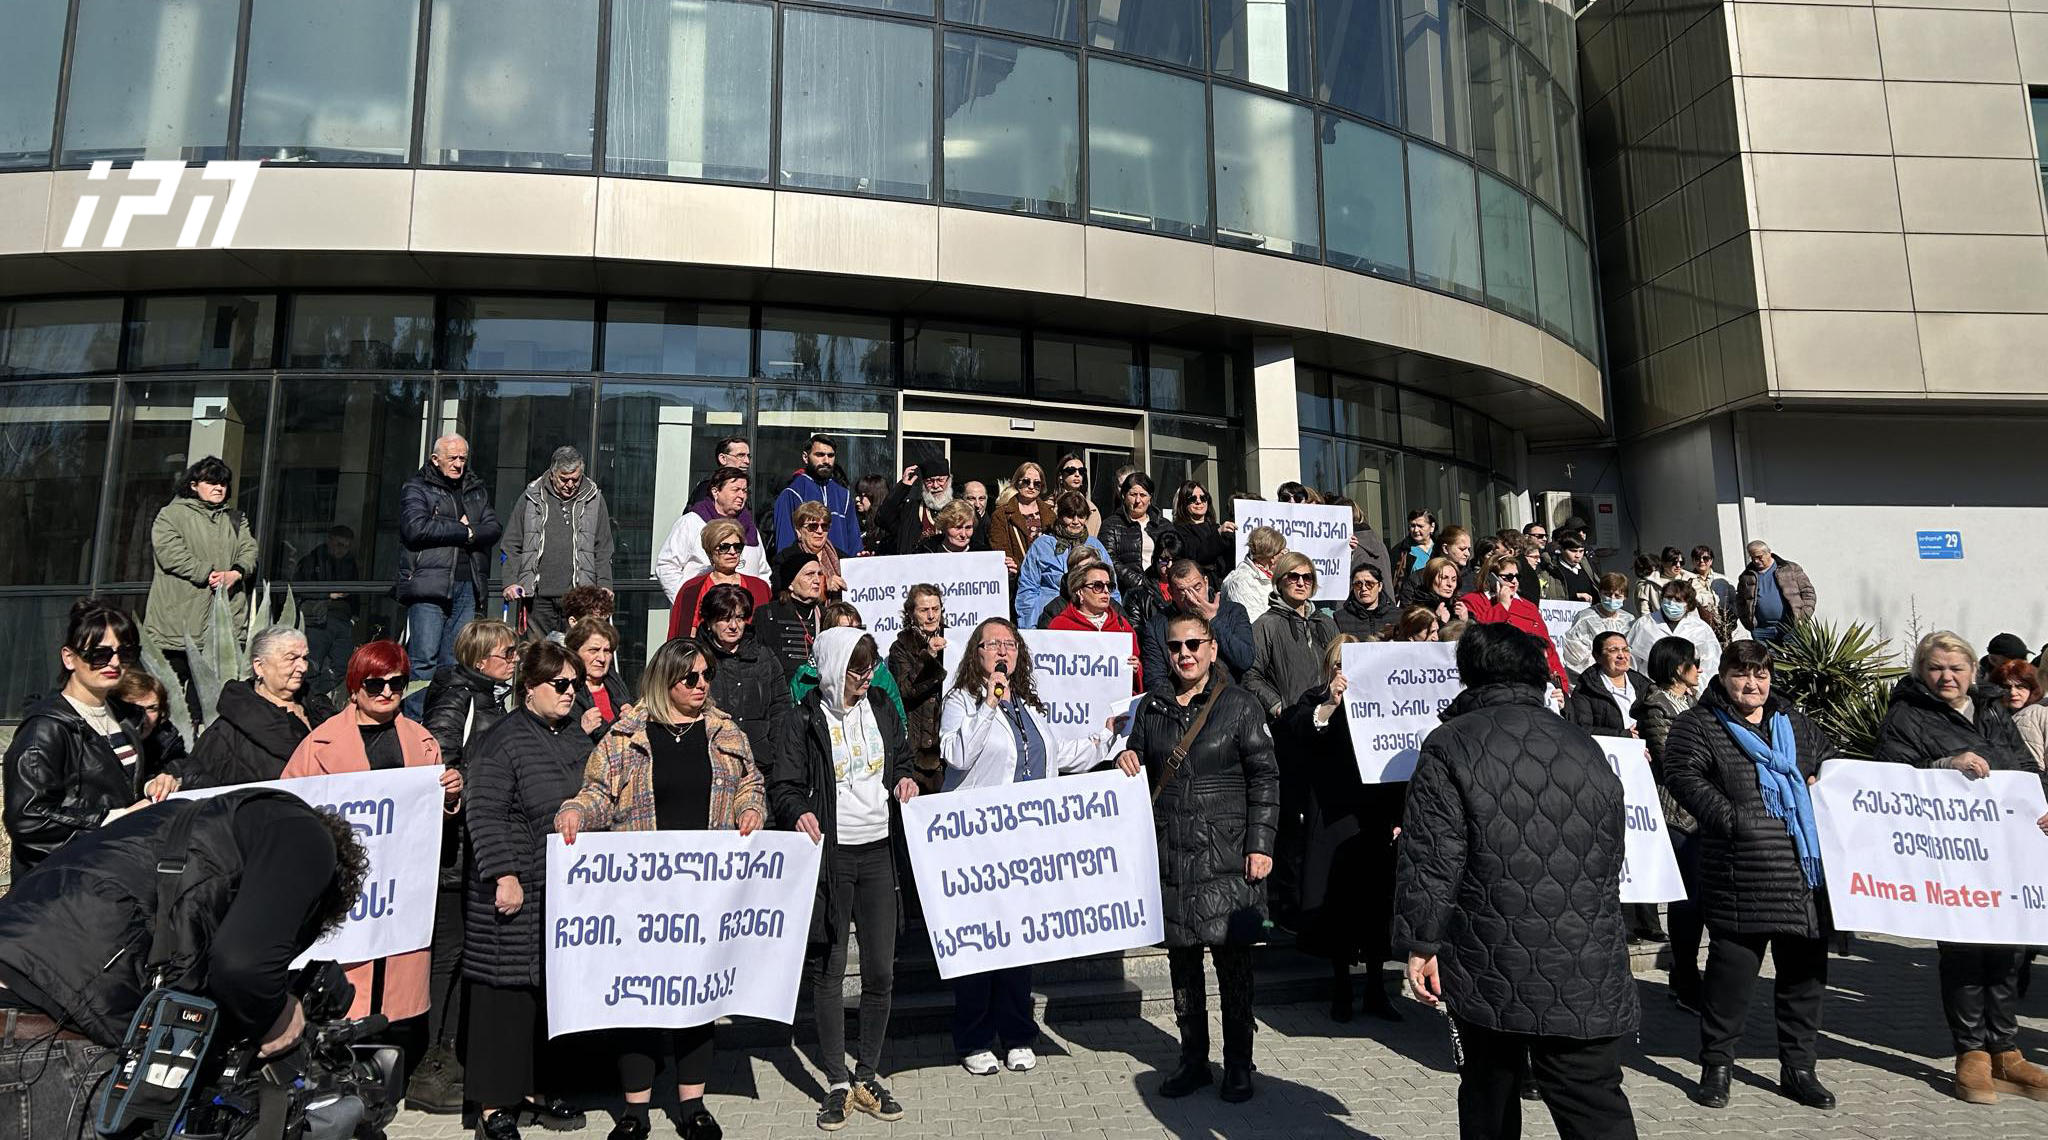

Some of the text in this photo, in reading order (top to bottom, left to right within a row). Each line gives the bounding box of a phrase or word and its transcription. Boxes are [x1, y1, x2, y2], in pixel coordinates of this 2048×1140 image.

[1945, 533, 1958, 548] 29
[850, 580, 1000, 603] ერთად გარჩინოთ
[1034, 653, 1119, 677] ლიკური
[1387, 668, 1460, 685] რესპუბლ
[1350, 701, 1385, 718] იყო,
[1391, 699, 1430, 716] არის
[926, 790, 1119, 842] რესპუბლიკური
[1852, 789, 2000, 822] რესპუბლიკური
[1892, 831, 1989, 861] მედიცინის
[567, 851, 785, 884] რესპუბლიკური
[941, 846, 1118, 897] საავადმყოფო
[1850, 872, 1917, 903] Alma
[1925, 880, 2002, 908] Mater
[555, 908, 785, 949] ჩემი, შენი, ჩვენი
[933, 899, 1147, 959] ხალხს ეკუთვნის!
[604, 967, 736, 1006] კლინიკაა!
